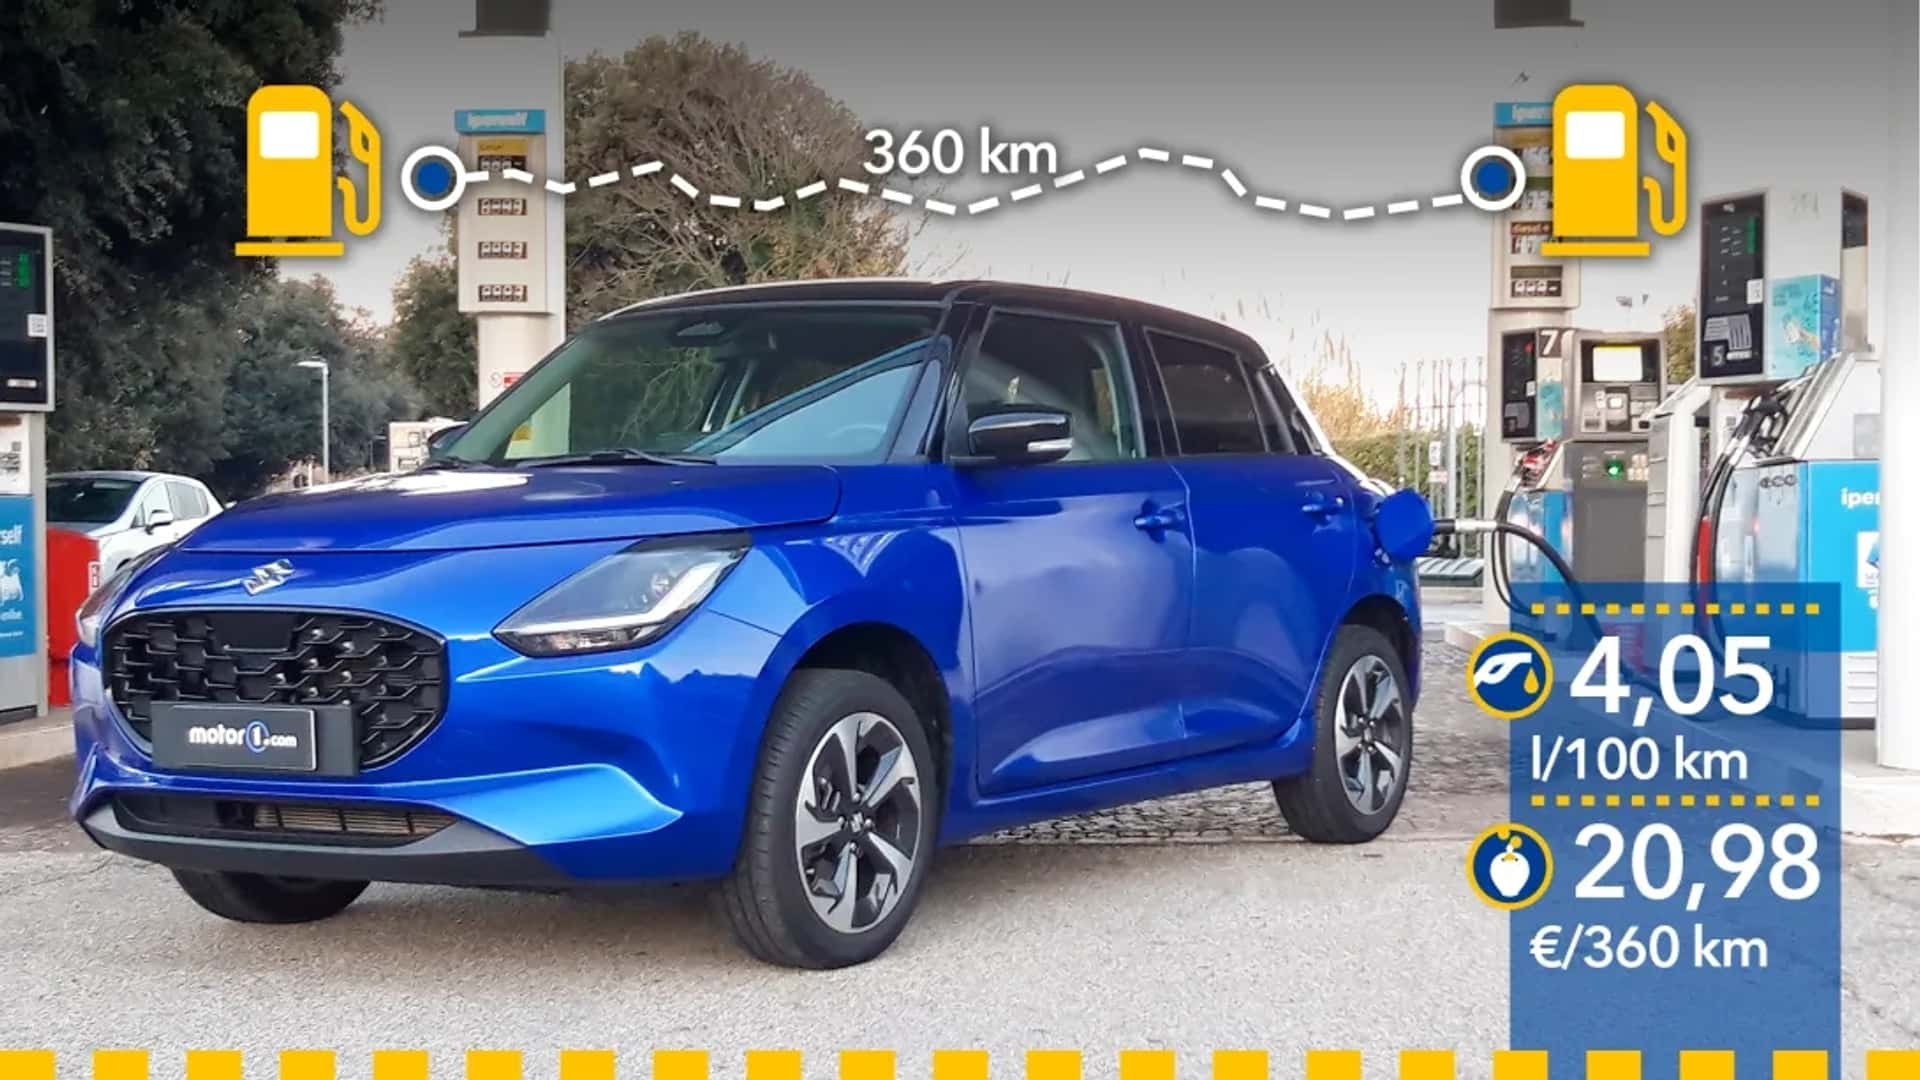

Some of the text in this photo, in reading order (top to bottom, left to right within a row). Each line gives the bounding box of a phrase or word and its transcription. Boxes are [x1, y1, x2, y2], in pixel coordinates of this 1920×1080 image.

[1540, 330, 1558, 355] 7
[1712, 345, 1725, 367] 5
[188, 721, 297, 752] motor1.com
